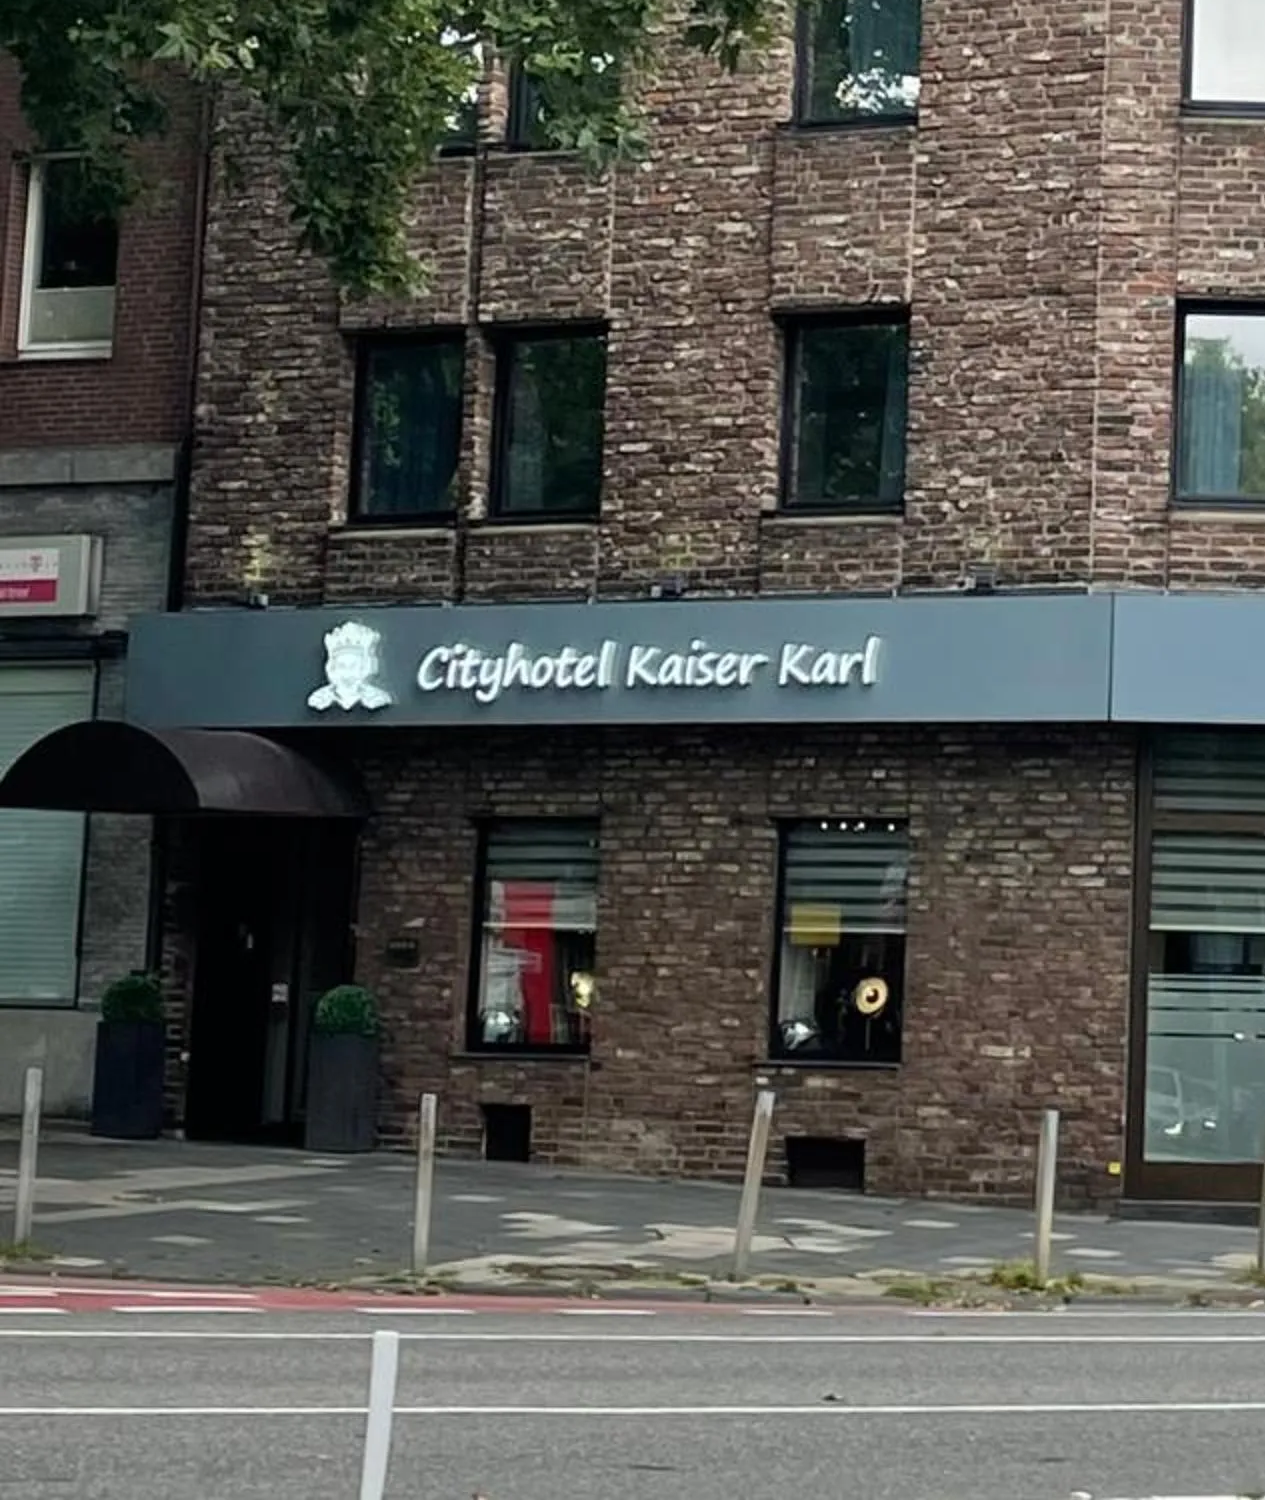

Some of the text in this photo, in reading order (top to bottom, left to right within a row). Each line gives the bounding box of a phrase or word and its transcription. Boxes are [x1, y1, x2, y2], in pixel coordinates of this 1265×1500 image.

[416, 635, 880, 703] Cityhotel Kaiser Karl
